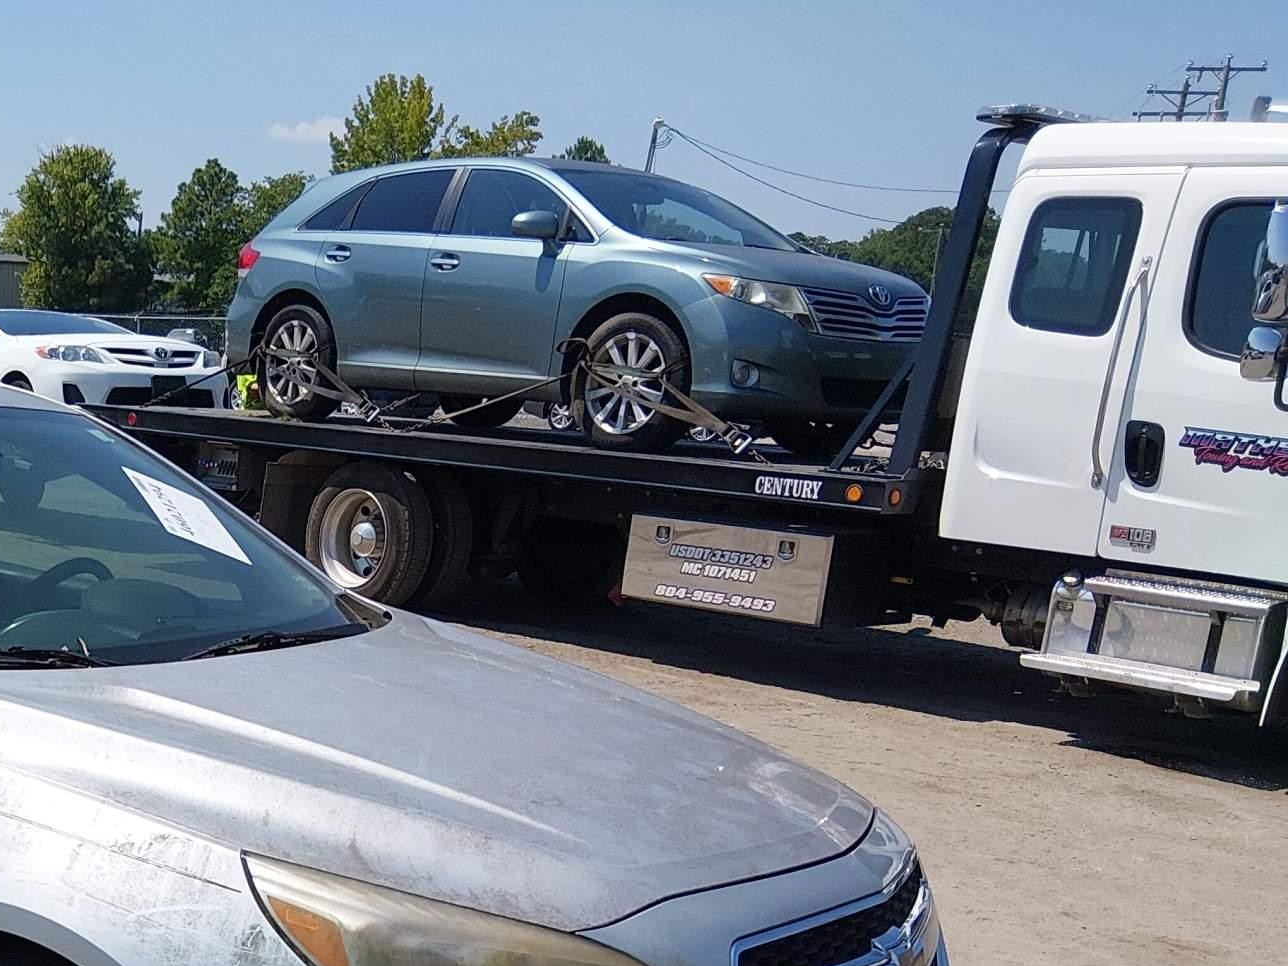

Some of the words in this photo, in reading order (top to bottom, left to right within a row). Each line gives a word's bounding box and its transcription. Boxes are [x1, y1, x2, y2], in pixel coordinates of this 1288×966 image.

[1194, 446, 1240, 474] Towing
[1239, 454, 1272, 471] and
[754, 475, 823, 500] CENTURY
[670, 544, 713, 560] USDOT
[711, 548, 774, 569] 3351243
[680, 561, 703, 577] MC
[702, 564, 758, 583] 1071451
[654, 584, 776, 612] 804-955-9493
